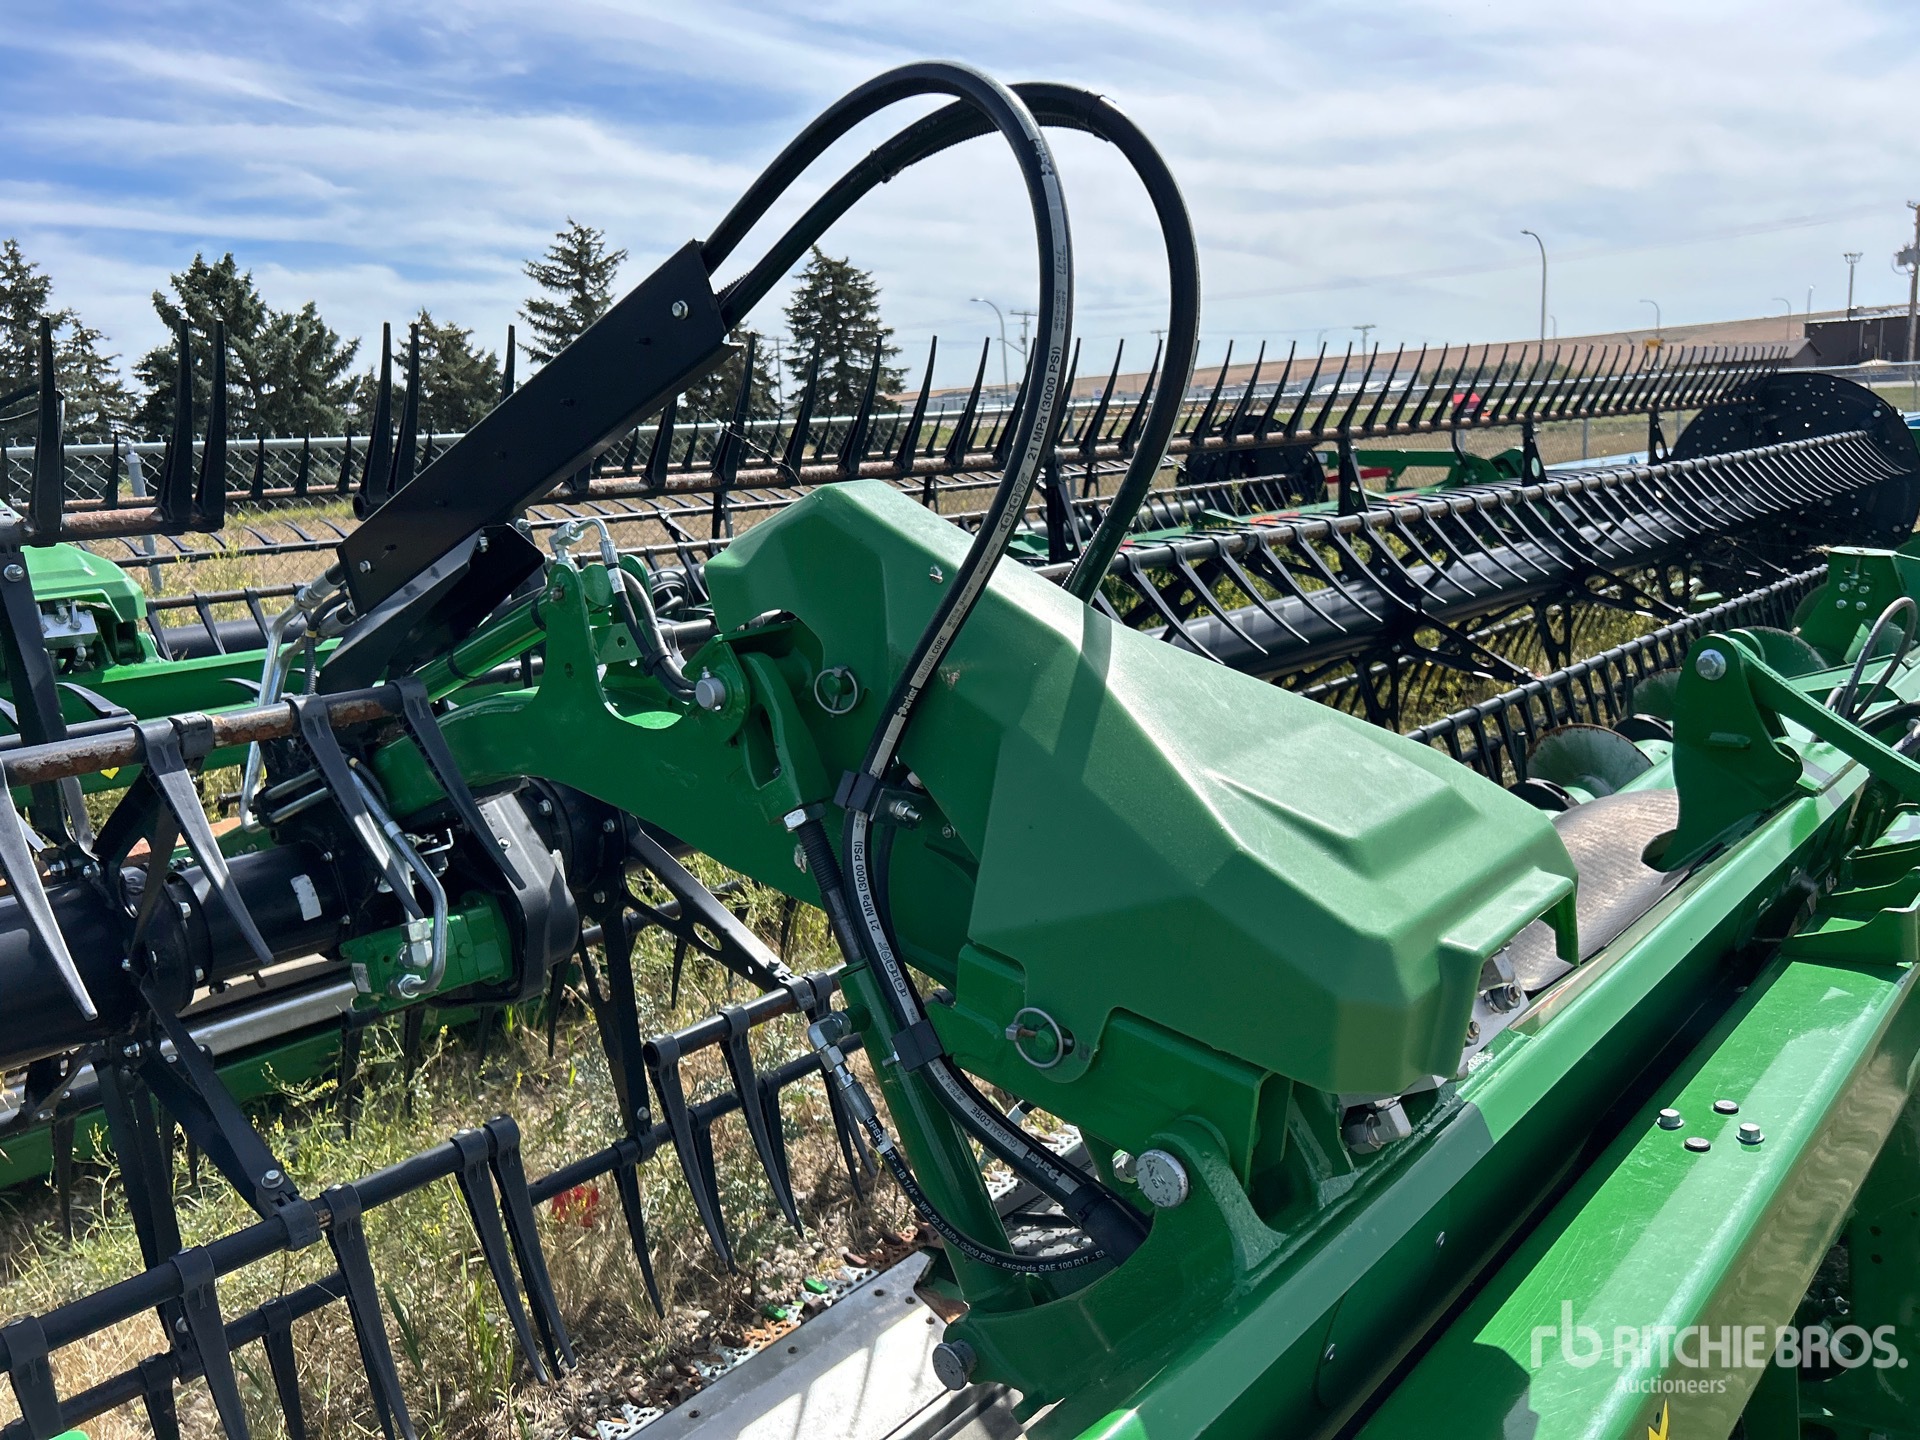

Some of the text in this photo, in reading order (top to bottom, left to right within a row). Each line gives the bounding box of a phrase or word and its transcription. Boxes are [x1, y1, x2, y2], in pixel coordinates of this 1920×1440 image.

[1027, 346, 1061, 461] 21 MPa (3000 PSI)
[897, 687, 919, 716] Parker
[854, 840, 880, 931] 21 MPa (3000 PSI)
[970, 1106, 1018, 1148] GLOBALCORE
[1026, 1151, 1060, 1180] Parker
[919, 1200, 932, 1215] WP
[929, 1214, 945, 1230] 22.5
[943, 1227, 960, 1245] MPa
[1002, 1261, 1037, 1272] exceeds
[1038, 1263, 1057, 1272] SAE
[1058, 1261, 1073, 1270] 100
[1074, 1256, 1089, 1267] R17
